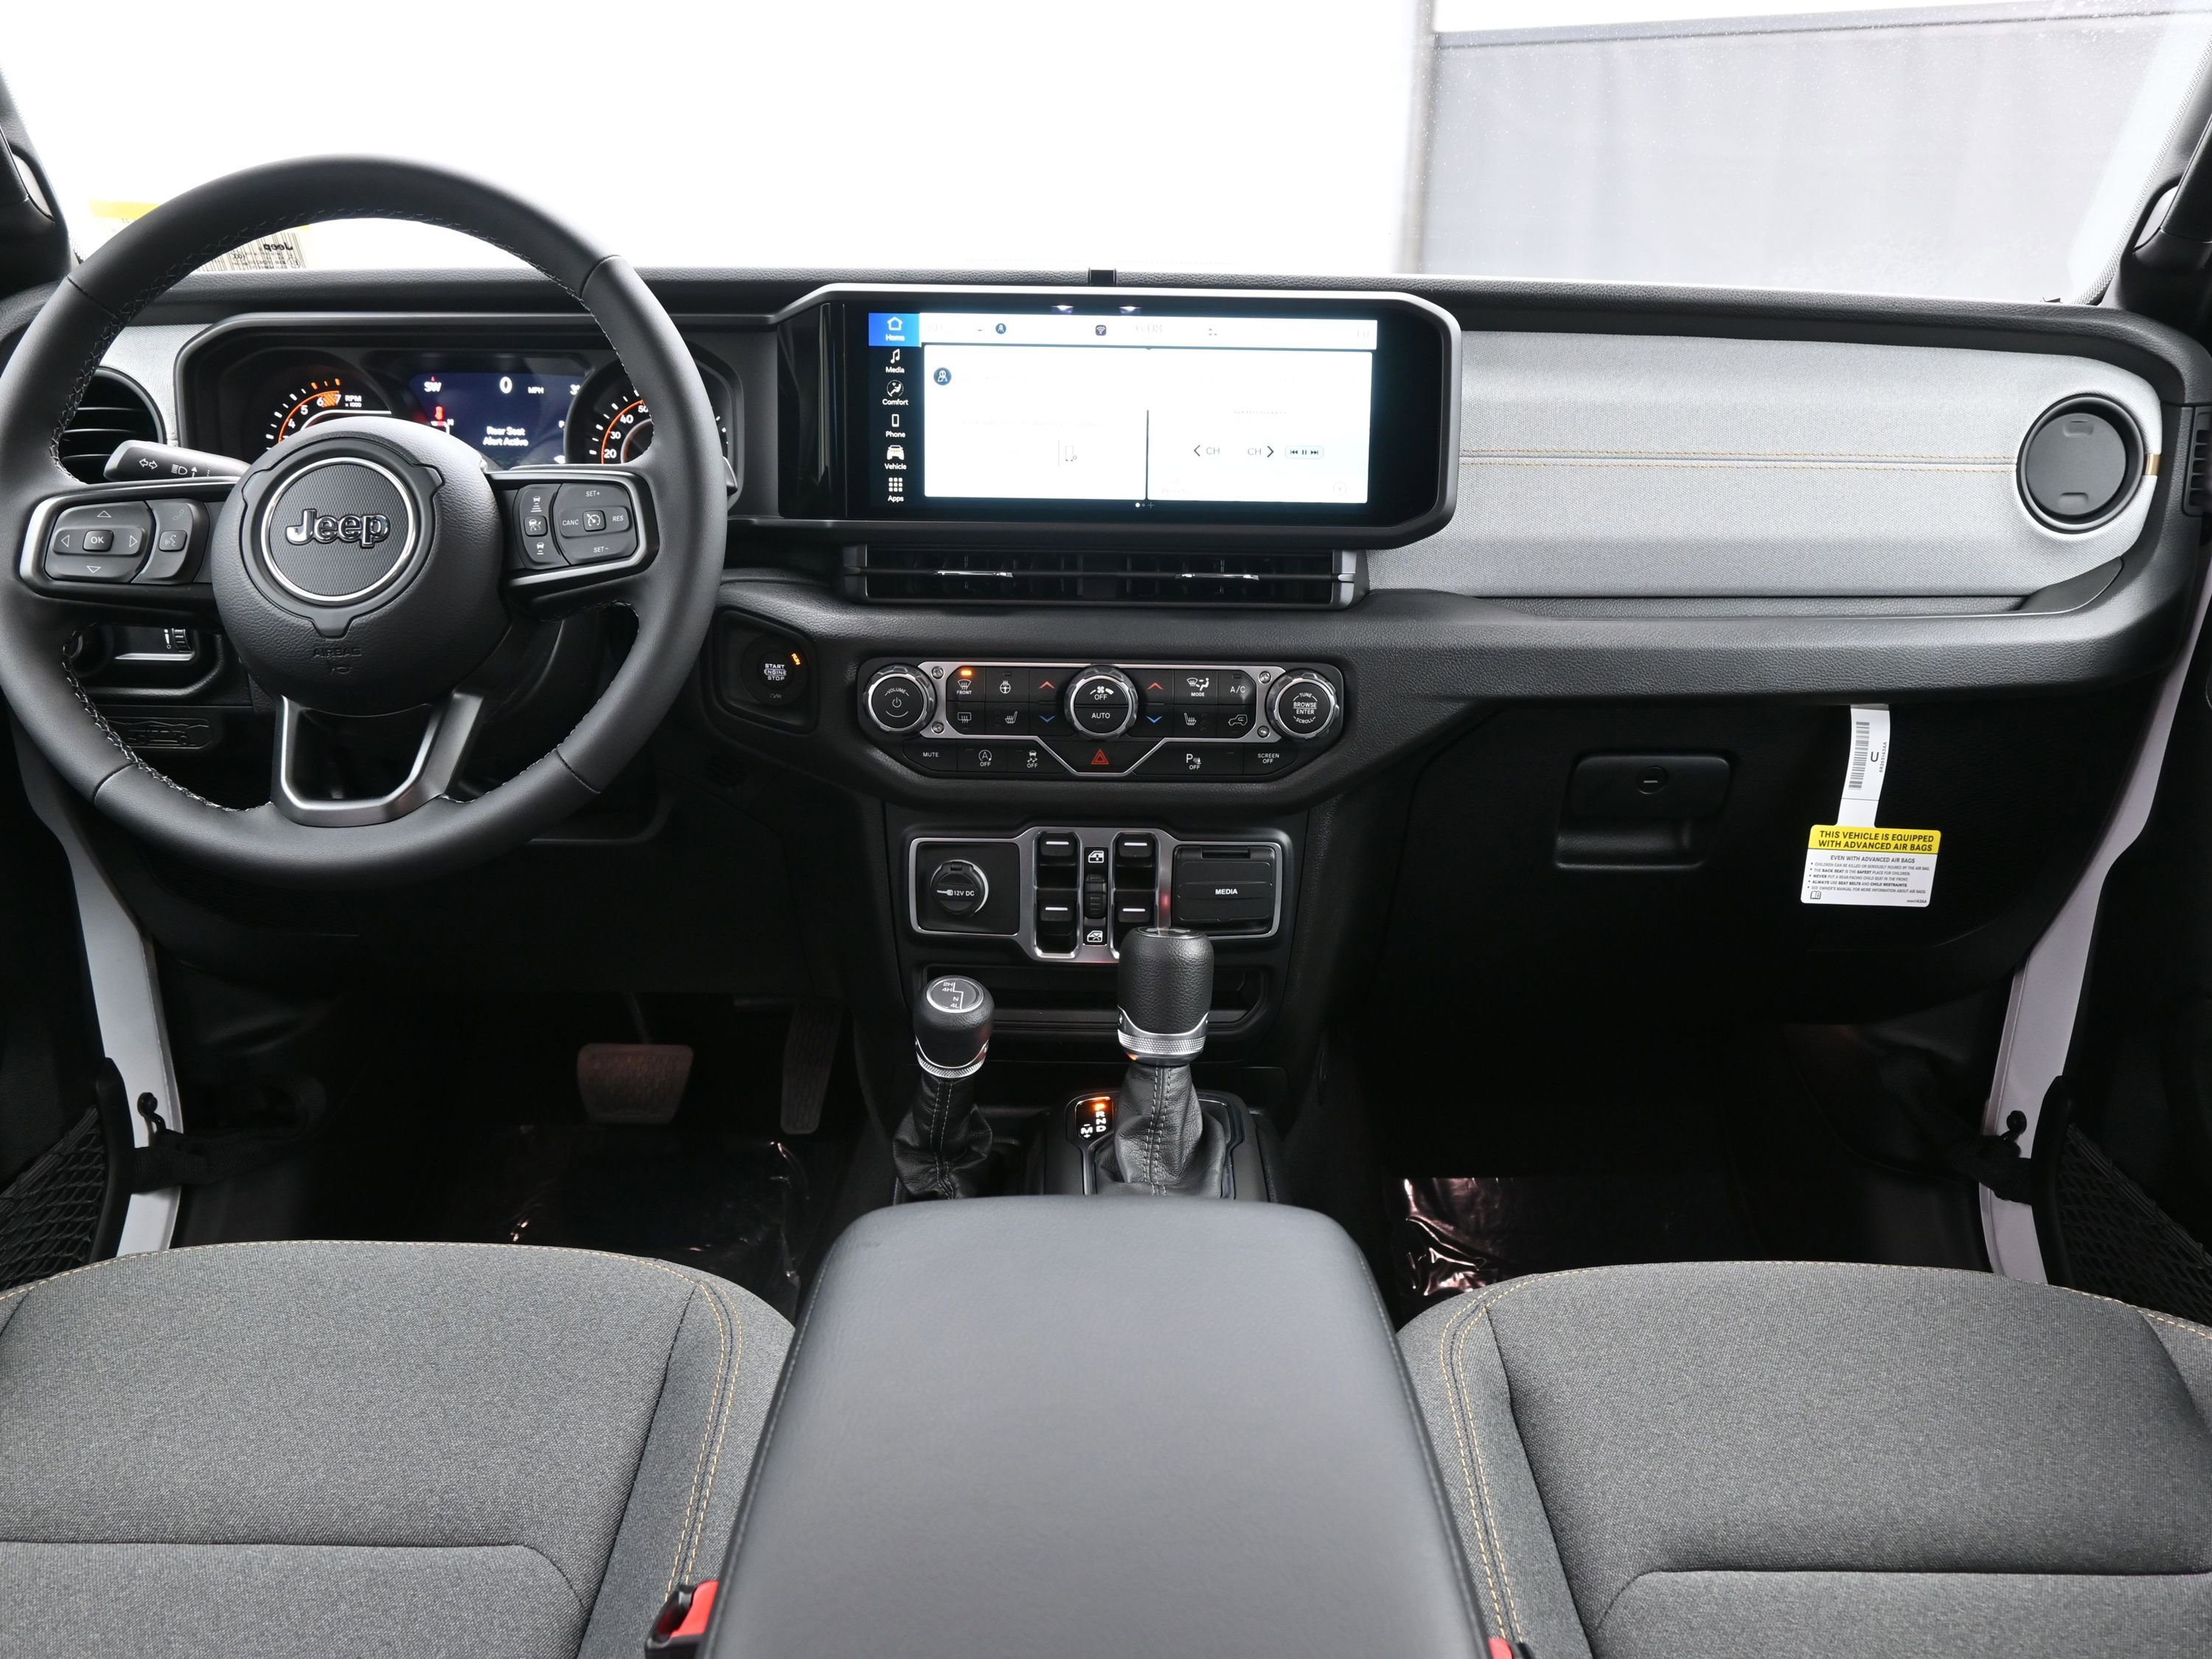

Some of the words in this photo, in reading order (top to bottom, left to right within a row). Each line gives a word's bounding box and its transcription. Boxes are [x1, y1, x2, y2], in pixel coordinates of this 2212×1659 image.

[424, 381, 442, 392] SW
[499, 376, 512, 394] 0
[316, 397, 324, 406] 6
[335, 394, 341, 404] 7
[300, 405, 308, 414] 5
[288, 419, 296, 428] 4
[620, 414, 634, 424] 40
[487, 425, 506, 435] Rear
[507, 426, 525, 436] Seat
[610, 431, 621, 439] 30
[483, 437, 503, 446] Alert
[503, 437, 529, 446] Active
[603, 449, 617, 459] 20
[1206, 447, 1220, 455] CH
[1247, 448, 1262, 456] CH
[285, 508, 391, 549] Jeep
[887, 686, 906, 695] VOLUME
[1186, 754, 1193, 763] P
[1871, 751, 1879, 762] U
[1842, 832, 1879, 840] VEHICLE
[1891, 834, 1934, 842] EQUIPPED
[1843, 841, 1891, 849] ADVANCED
[1910, 844, 1933, 852] BAGS
